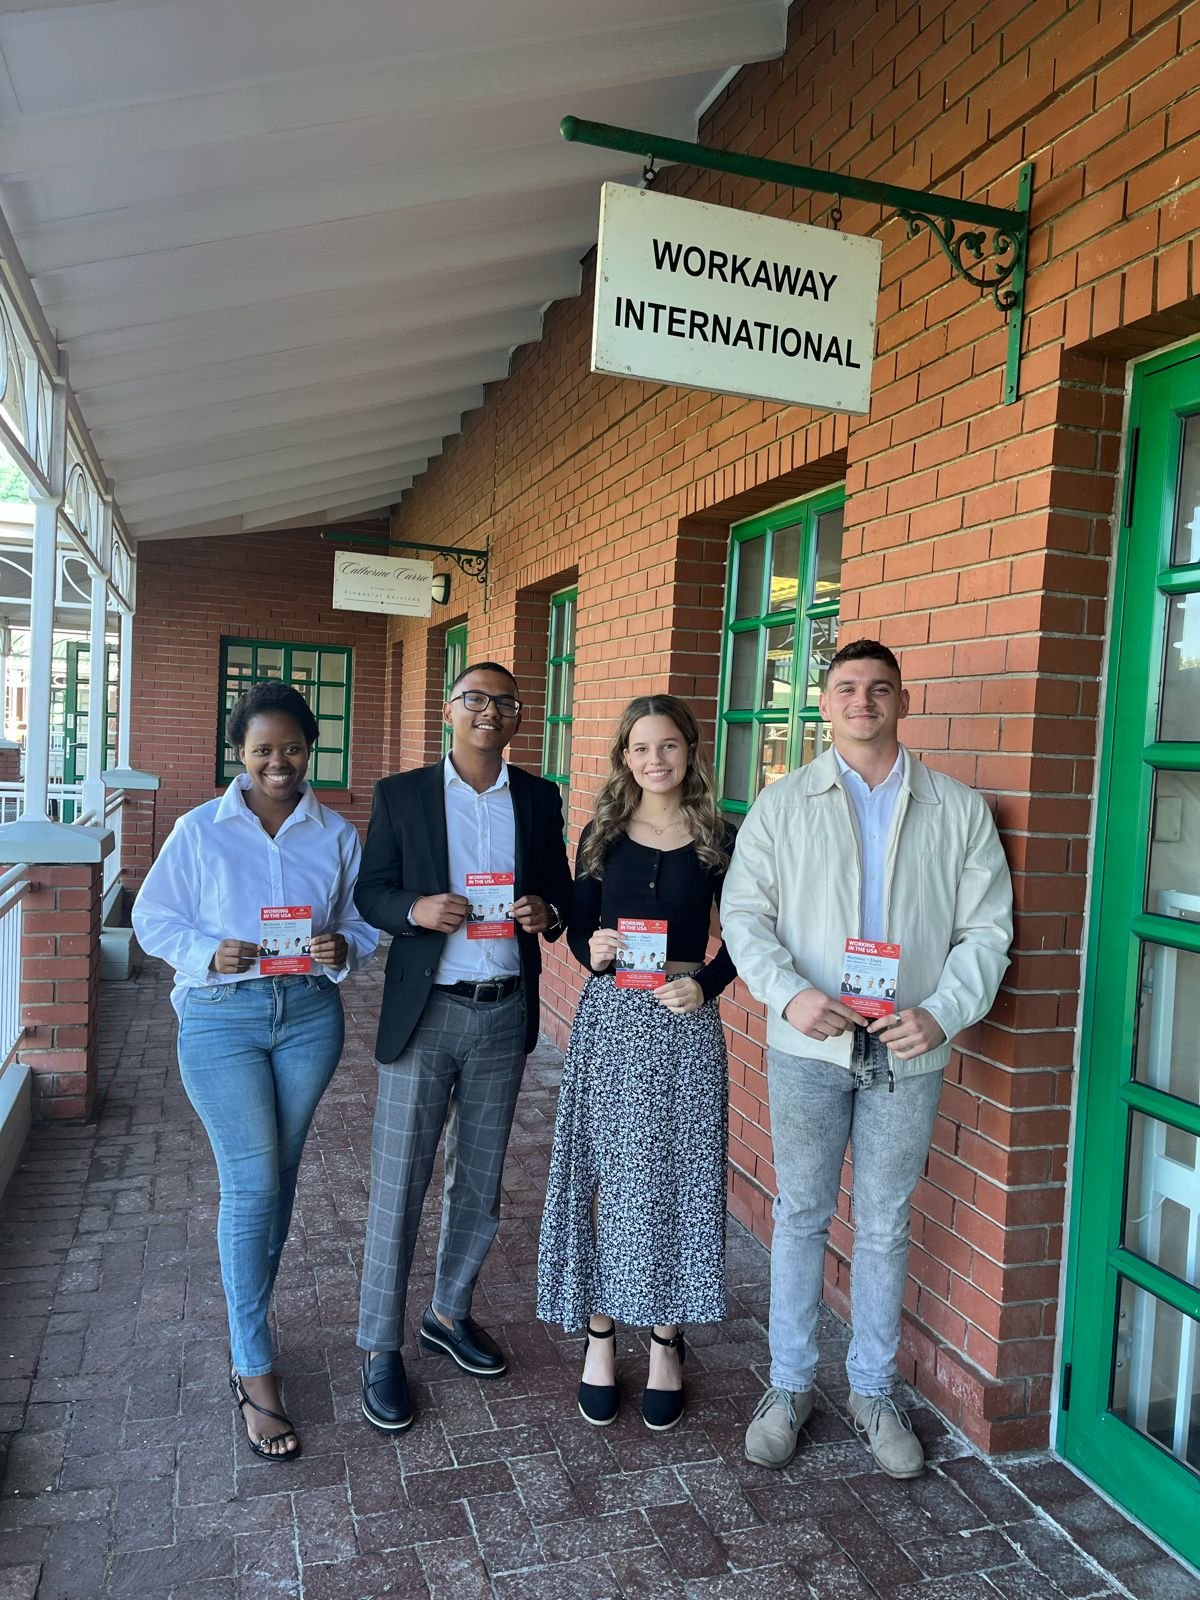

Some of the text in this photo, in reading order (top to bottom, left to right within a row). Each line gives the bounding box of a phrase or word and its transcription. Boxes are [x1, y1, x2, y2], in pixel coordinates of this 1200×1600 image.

[652, 238, 838, 302] WORKAWAY
[614, 296, 861, 369] INTERNATIONAL
[339, 561, 430, 582] Catherine Currie
[387, 594, 420, 602] Services
[848, 940, 876, 948] WORKING
